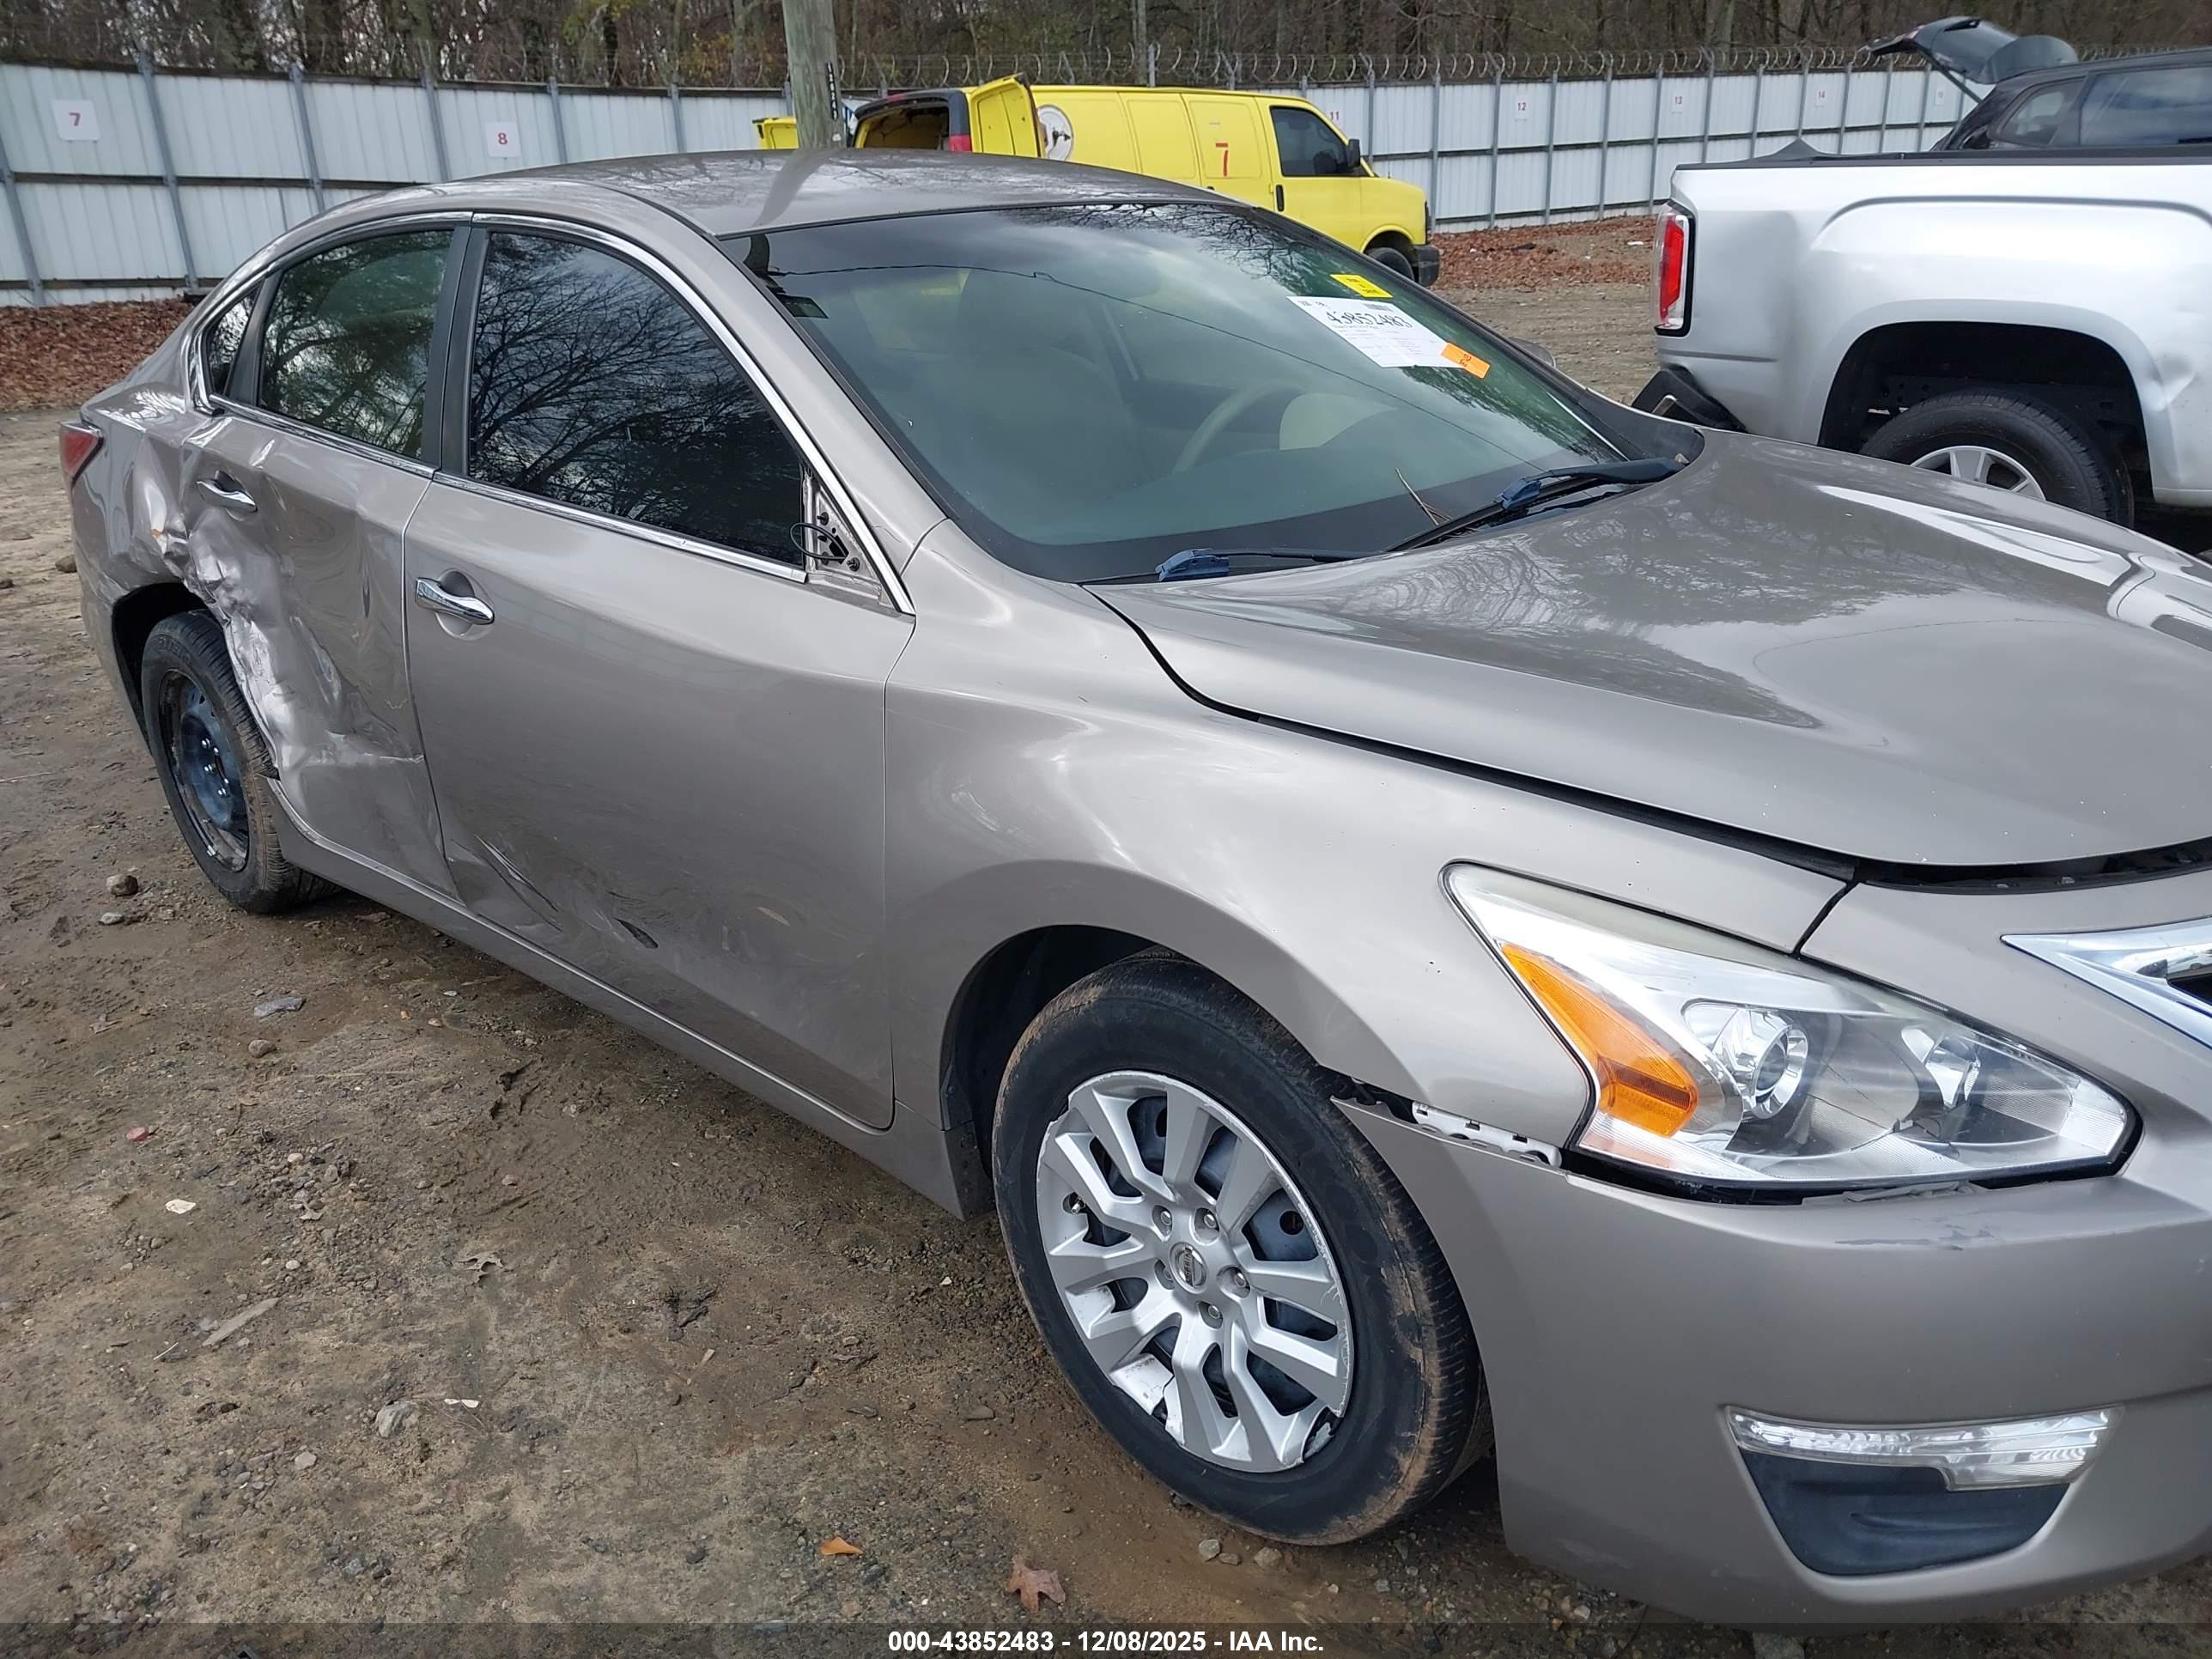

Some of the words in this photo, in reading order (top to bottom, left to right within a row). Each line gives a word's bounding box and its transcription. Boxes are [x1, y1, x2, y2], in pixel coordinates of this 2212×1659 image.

[1518, 102, 1526, 111] 12
[69, 112, 81, 126] 7
[498, 132, 507, 145] 8
[1215, 143, 1229, 177] 7
